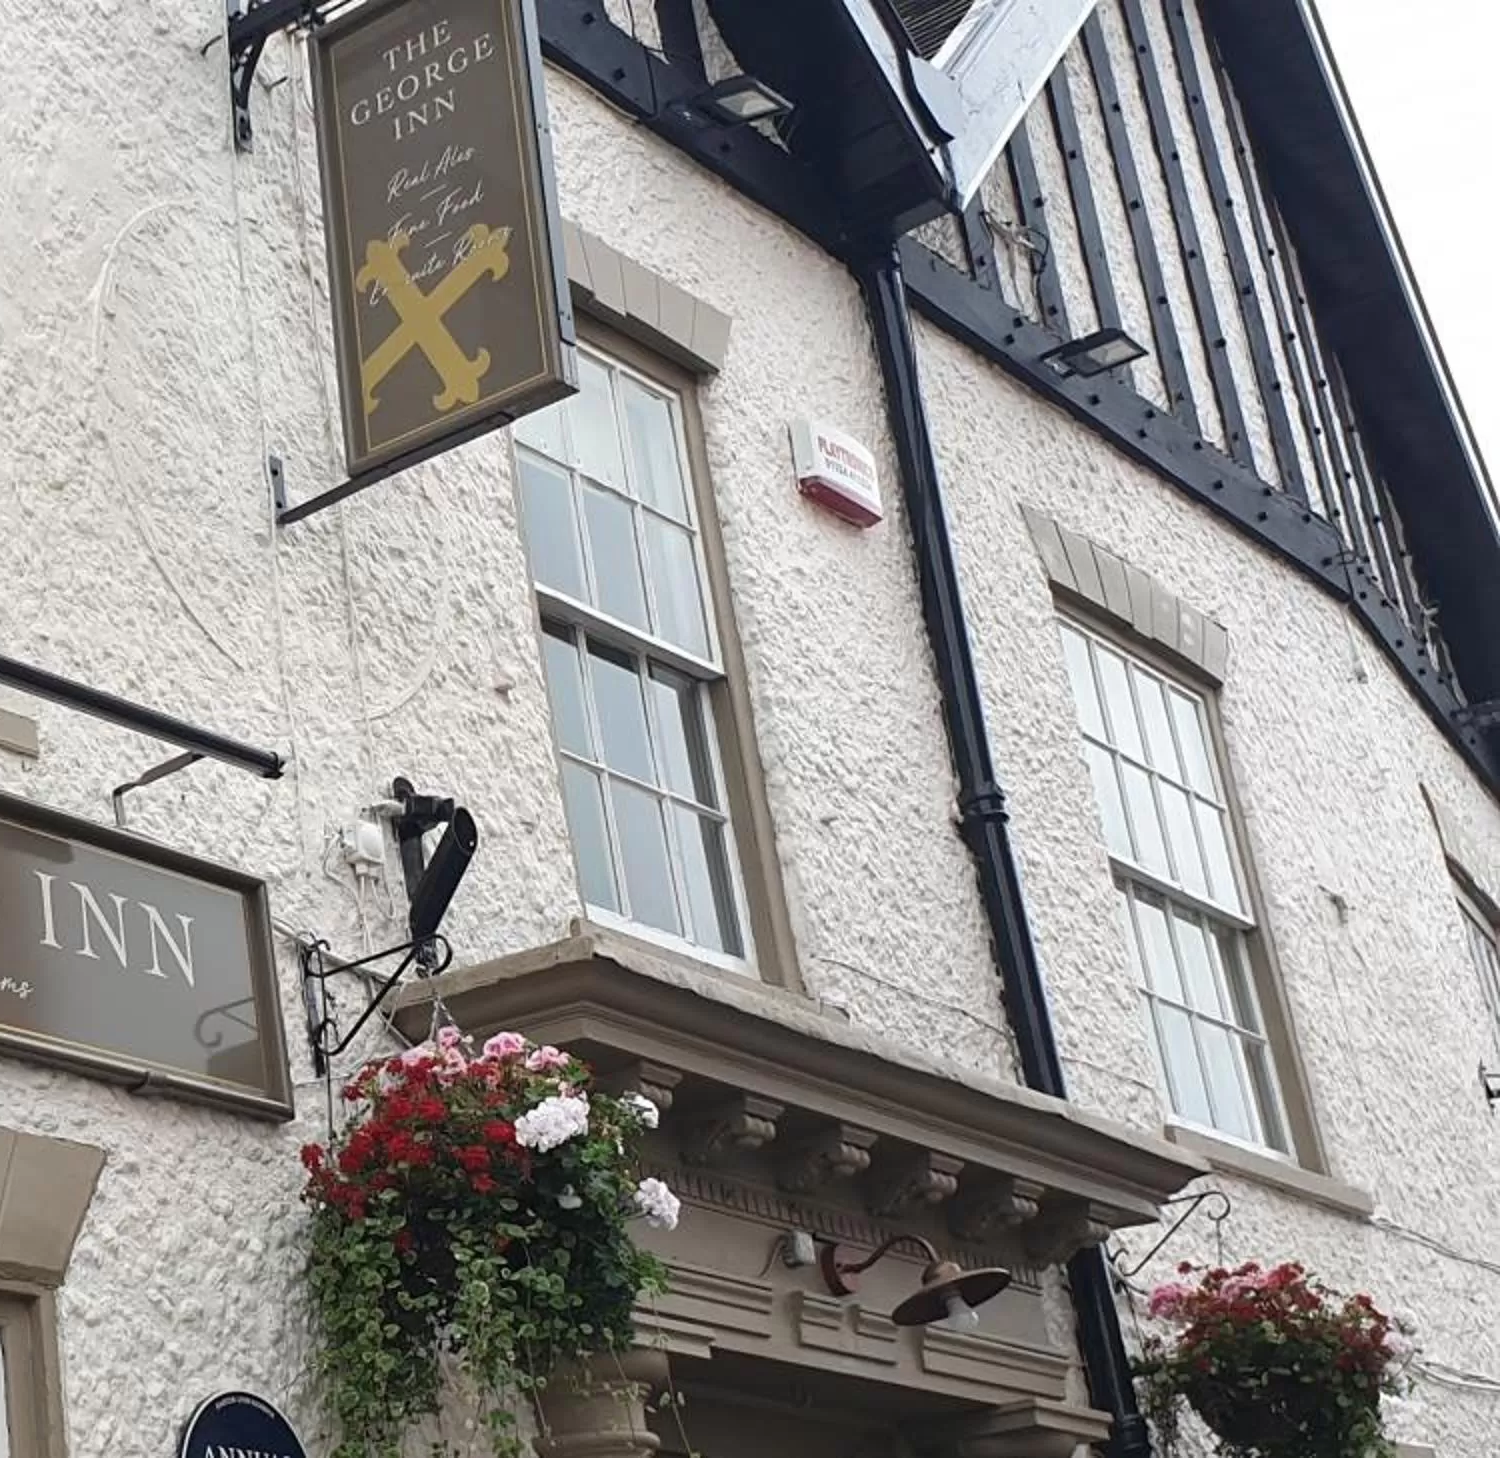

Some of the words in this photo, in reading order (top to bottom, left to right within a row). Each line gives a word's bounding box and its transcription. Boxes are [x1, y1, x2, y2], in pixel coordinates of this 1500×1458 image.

[382, 20, 451, 71] THE
[351, 33, 495, 125] GEORGE
[393, 88, 455, 142] INN
[387, 158, 431, 204] Real
[433, 144, 477, 182] Ales
[436, 178, 485, 227] Food
[33, 870, 197, 990] INN
